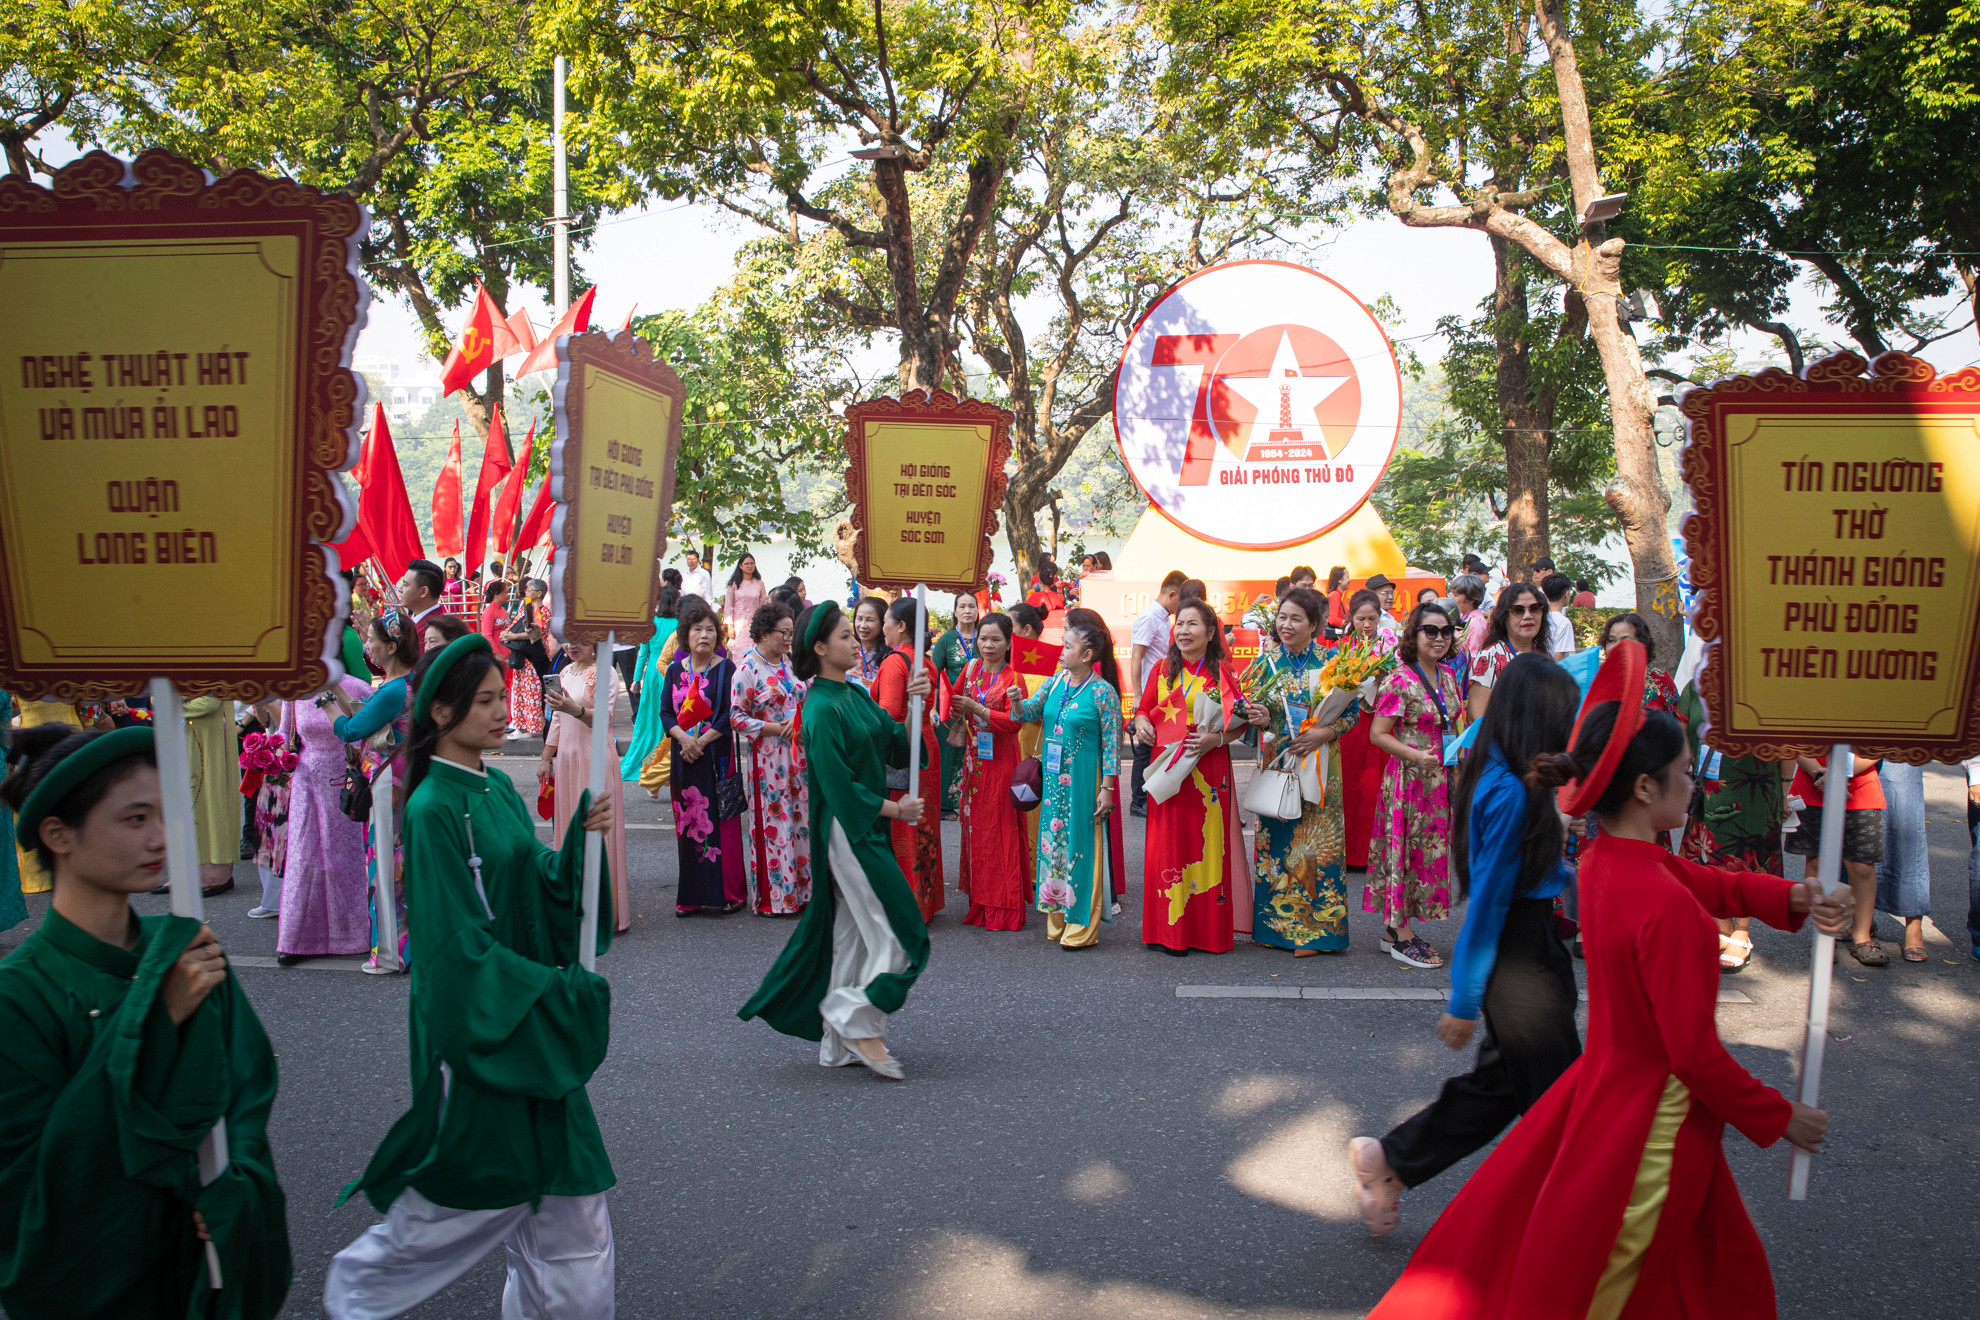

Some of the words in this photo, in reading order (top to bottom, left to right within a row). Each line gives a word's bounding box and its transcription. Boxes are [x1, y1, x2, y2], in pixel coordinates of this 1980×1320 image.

[21, 352, 94, 393] NGHỆ
[101, 350, 189, 392] THUẬT
[197, 344, 250, 385] HÁT
[82, 399, 146, 440] MÚA
[186, 405, 240, 438] LAO
[901, 463, 917, 479] HỘI
[920, 463, 950, 478] GIÓNG
[1220, 466, 1247, 485] GIẢI
[1252, 466, 1300, 484] PHÓNG
[1304, 464, 1331, 483] THỦ
[1335, 464, 1354, 483] ĐÔ
[1781, 454, 1824, 492] TÍN
[1832, 457, 1944, 492] NGƯỠNG
[107, 477, 180, 518] QUẬN
[894, 483, 909, 498] TẠI
[912, 481, 933, 497] ĐỀN
[935, 482, 956, 498] SÓC
[607, 513, 632, 538] HUYỆN
[906, 511, 940, 527] HUYỆN
[1832, 502, 1889, 539] THỜ
[77, 532, 147, 564] LONG
[154, 529, 217, 563] BIÊN
[901, 528, 921, 543] SÓC
[924, 530, 945, 544] SƠN
[601, 543, 614, 563] GIA
[1767, 548, 1855, 586] THÁNH
[1863, 550, 1945, 587] GIÓNG
[1784, 595, 1837, 632] PHÙ
[1844, 594, 1919, 634] ĐỔNG
[1760, 646, 1837, 678] THIÊN
